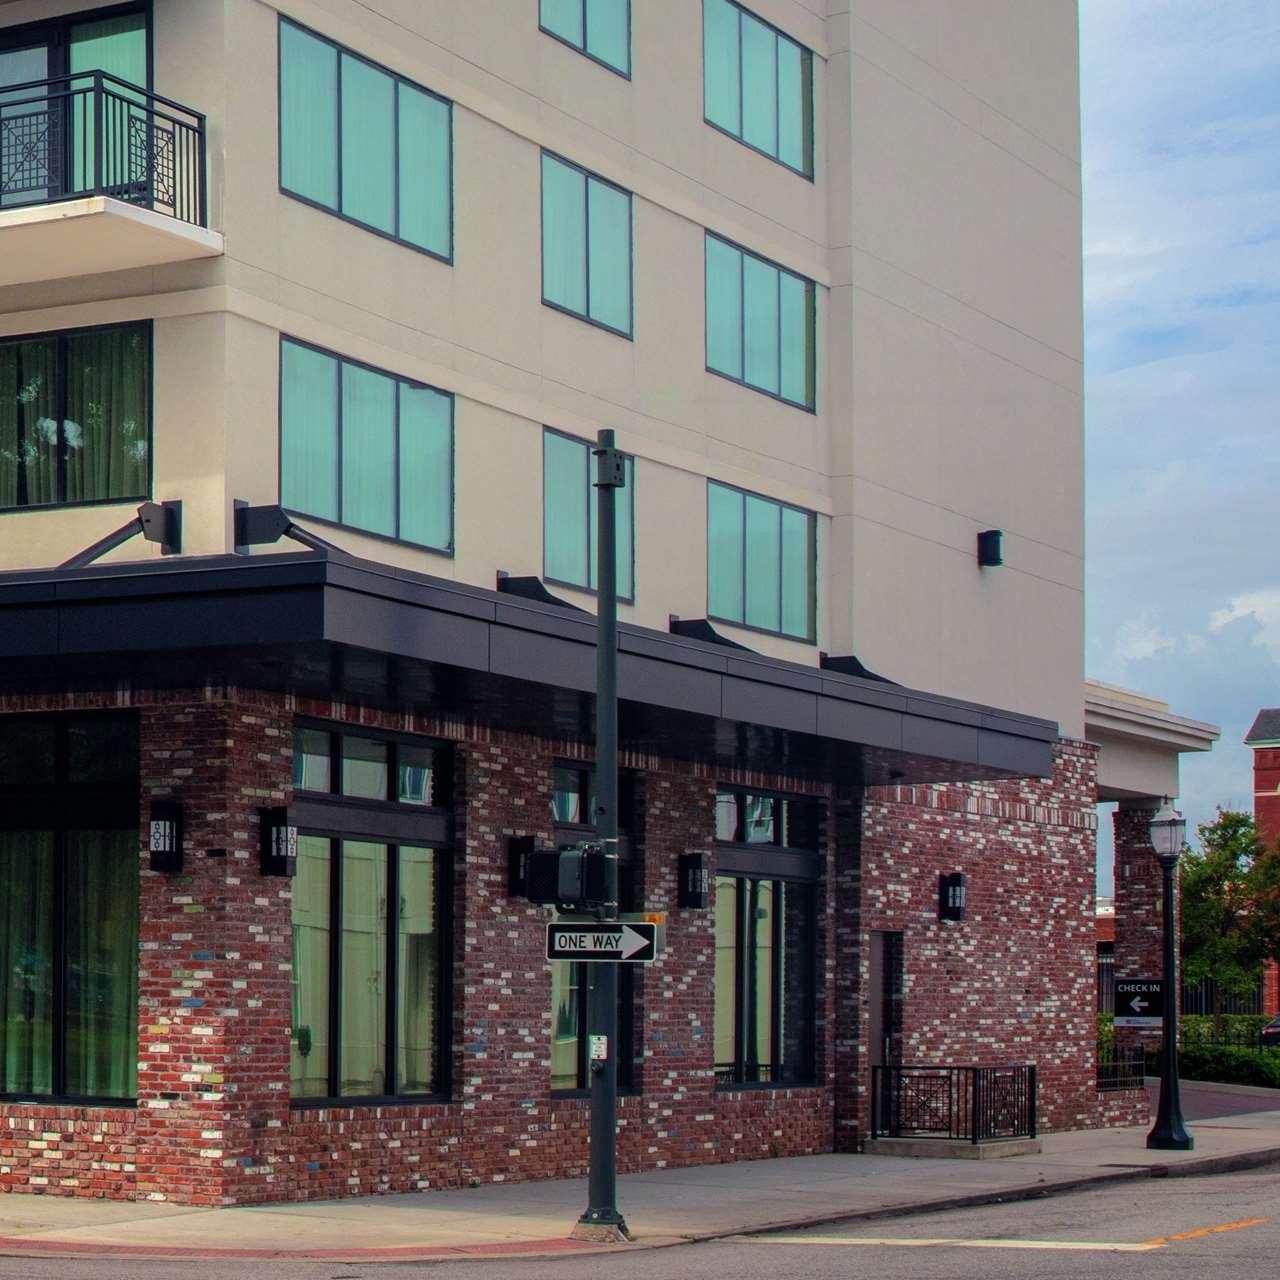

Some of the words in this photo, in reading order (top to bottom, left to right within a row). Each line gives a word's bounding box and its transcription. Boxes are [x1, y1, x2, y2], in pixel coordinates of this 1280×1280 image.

[558, 935, 587, 949] ONE
[592, 934, 622, 949] WAY
[1118, 984, 1149, 992] CHECK
[1150, 984, 1161, 992] IN
